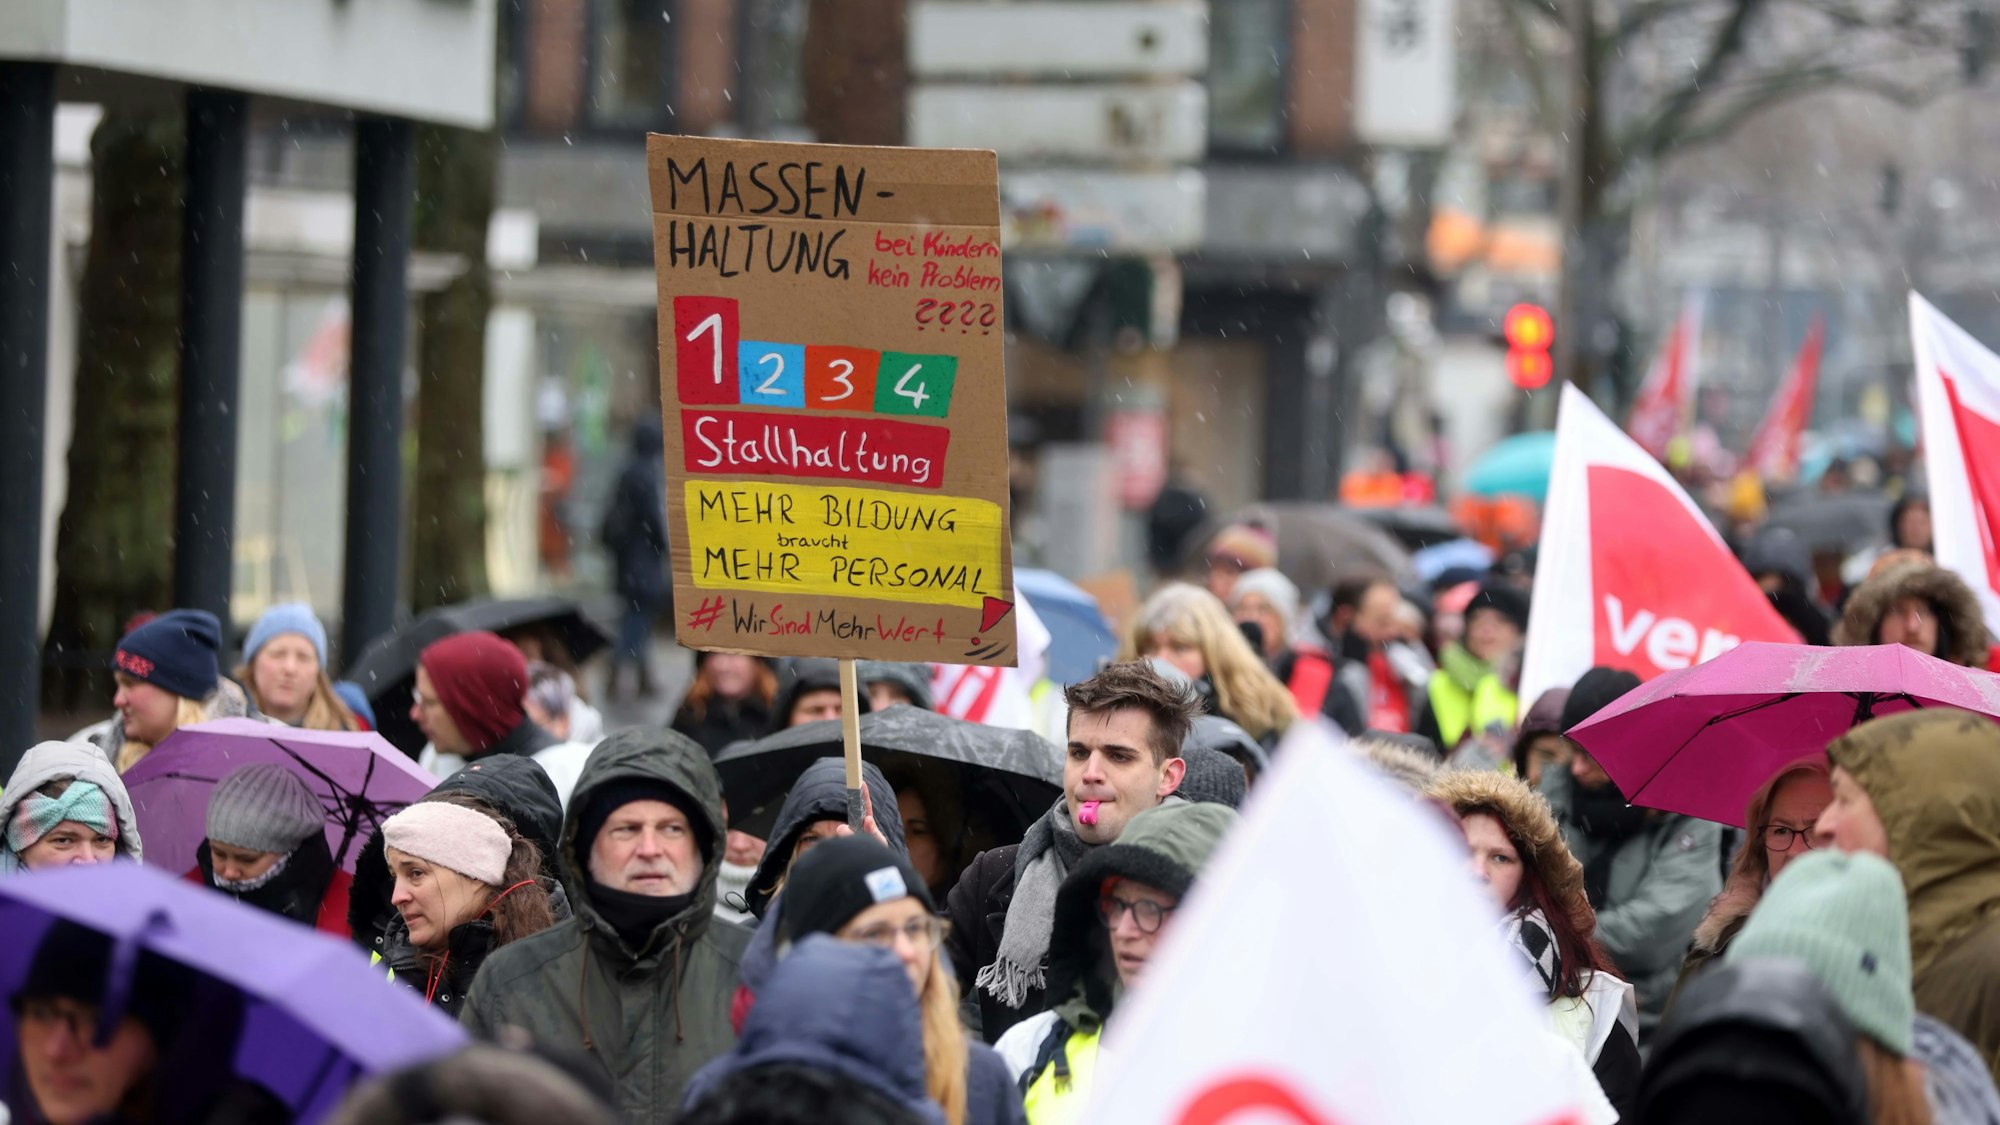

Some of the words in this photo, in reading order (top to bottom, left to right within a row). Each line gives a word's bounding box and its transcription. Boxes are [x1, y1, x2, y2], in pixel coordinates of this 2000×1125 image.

[667, 157, 895, 219] MASSEN-
[670, 220, 849, 280] HALTUNG
[875, 229, 915, 257] bei
[923, 231, 998, 259] Kindern
[868, 259, 909, 288] kein
[920, 261, 1001, 293] Problem
[686, 313, 723, 385] 1
[755, 353, 788, 395] 2
[820, 359, 855, 401] 3
[894, 363, 930, 409] 4
[695, 415, 931, 483] Stallhaltung
[700, 490, 796, 525] MEHR
[820, 494, 957, 533] BILDUNG
[778, 533, 849, 550] braucht
[703, 547, 801, 582] MEHR
[831, 556, 988, 595] PERSONAL
